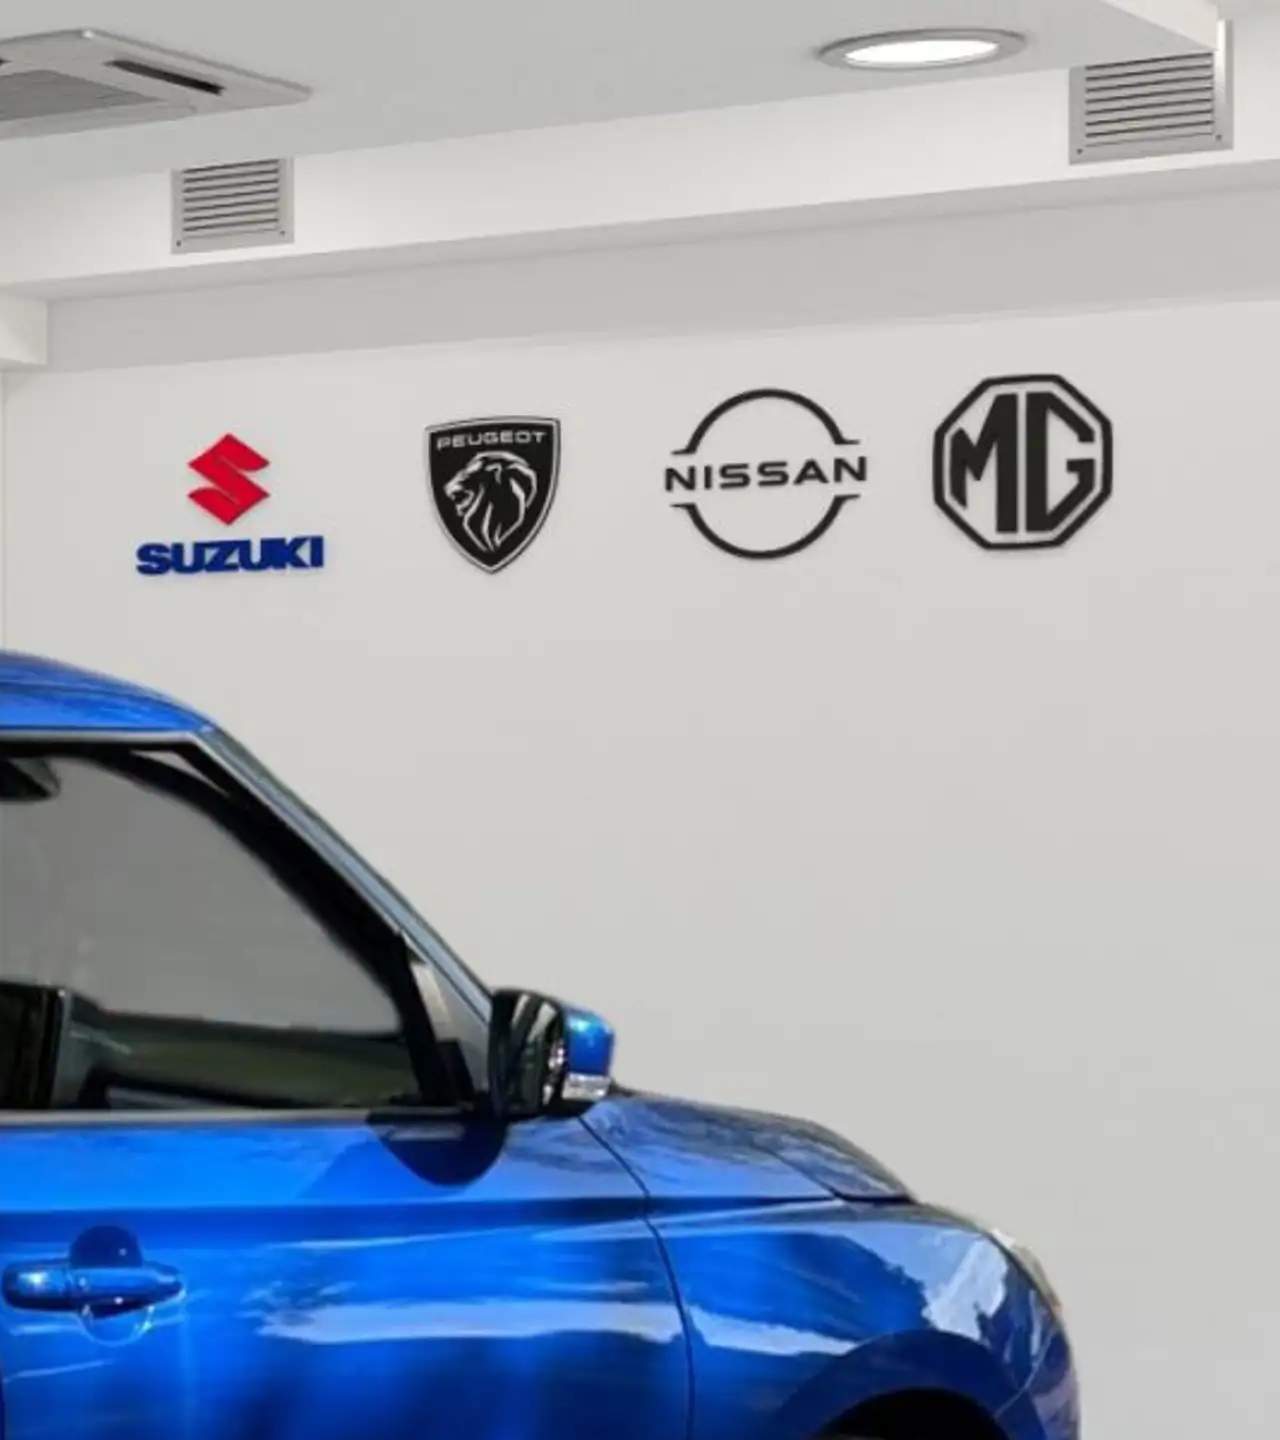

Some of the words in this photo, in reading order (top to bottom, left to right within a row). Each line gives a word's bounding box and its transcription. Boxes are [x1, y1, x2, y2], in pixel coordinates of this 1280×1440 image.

[436, 430, 547, 450] PEUGEOT
[664, 454, 868, 493] NISSAN
[948, 391, 1097, 534] MG
[136, 535, 325, 576] SUZUKI
